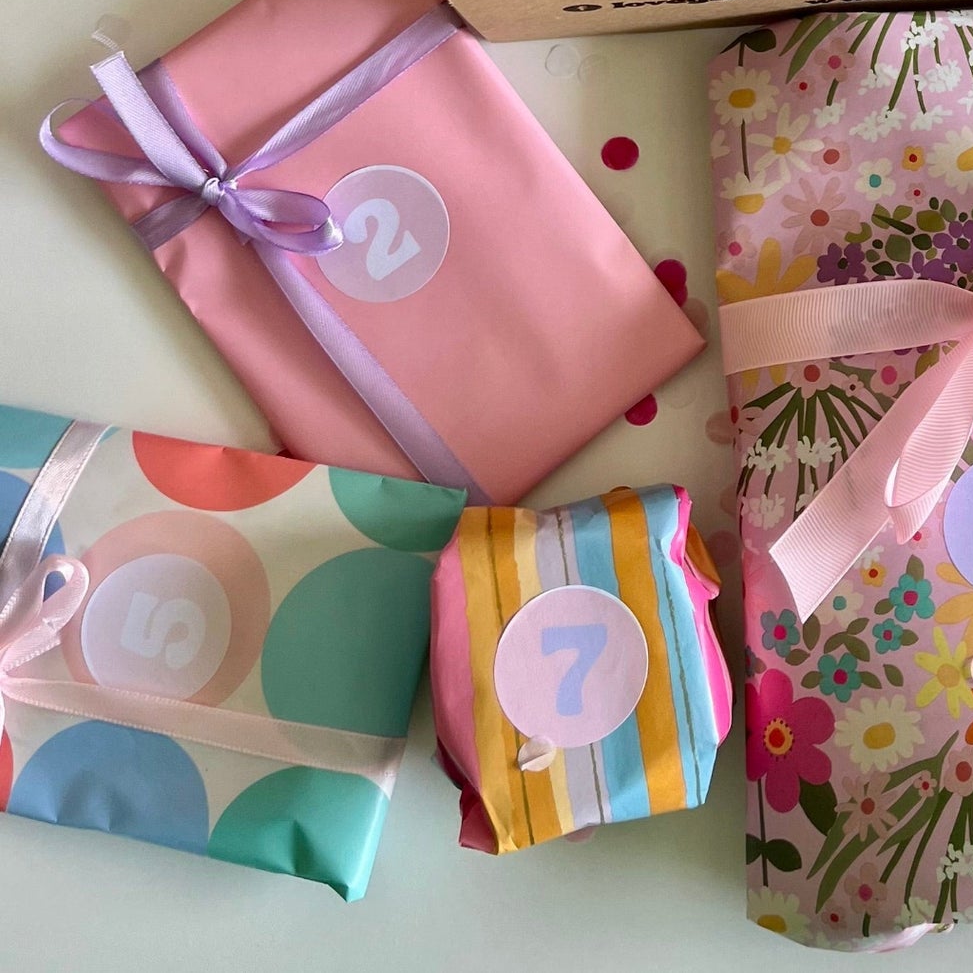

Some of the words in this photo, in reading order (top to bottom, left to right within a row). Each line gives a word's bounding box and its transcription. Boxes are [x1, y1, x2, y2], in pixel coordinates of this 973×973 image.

[343, 198, 422, 281] 2
[119, 591, 207, 670] 5
[541, 624, 608, 717] 7
